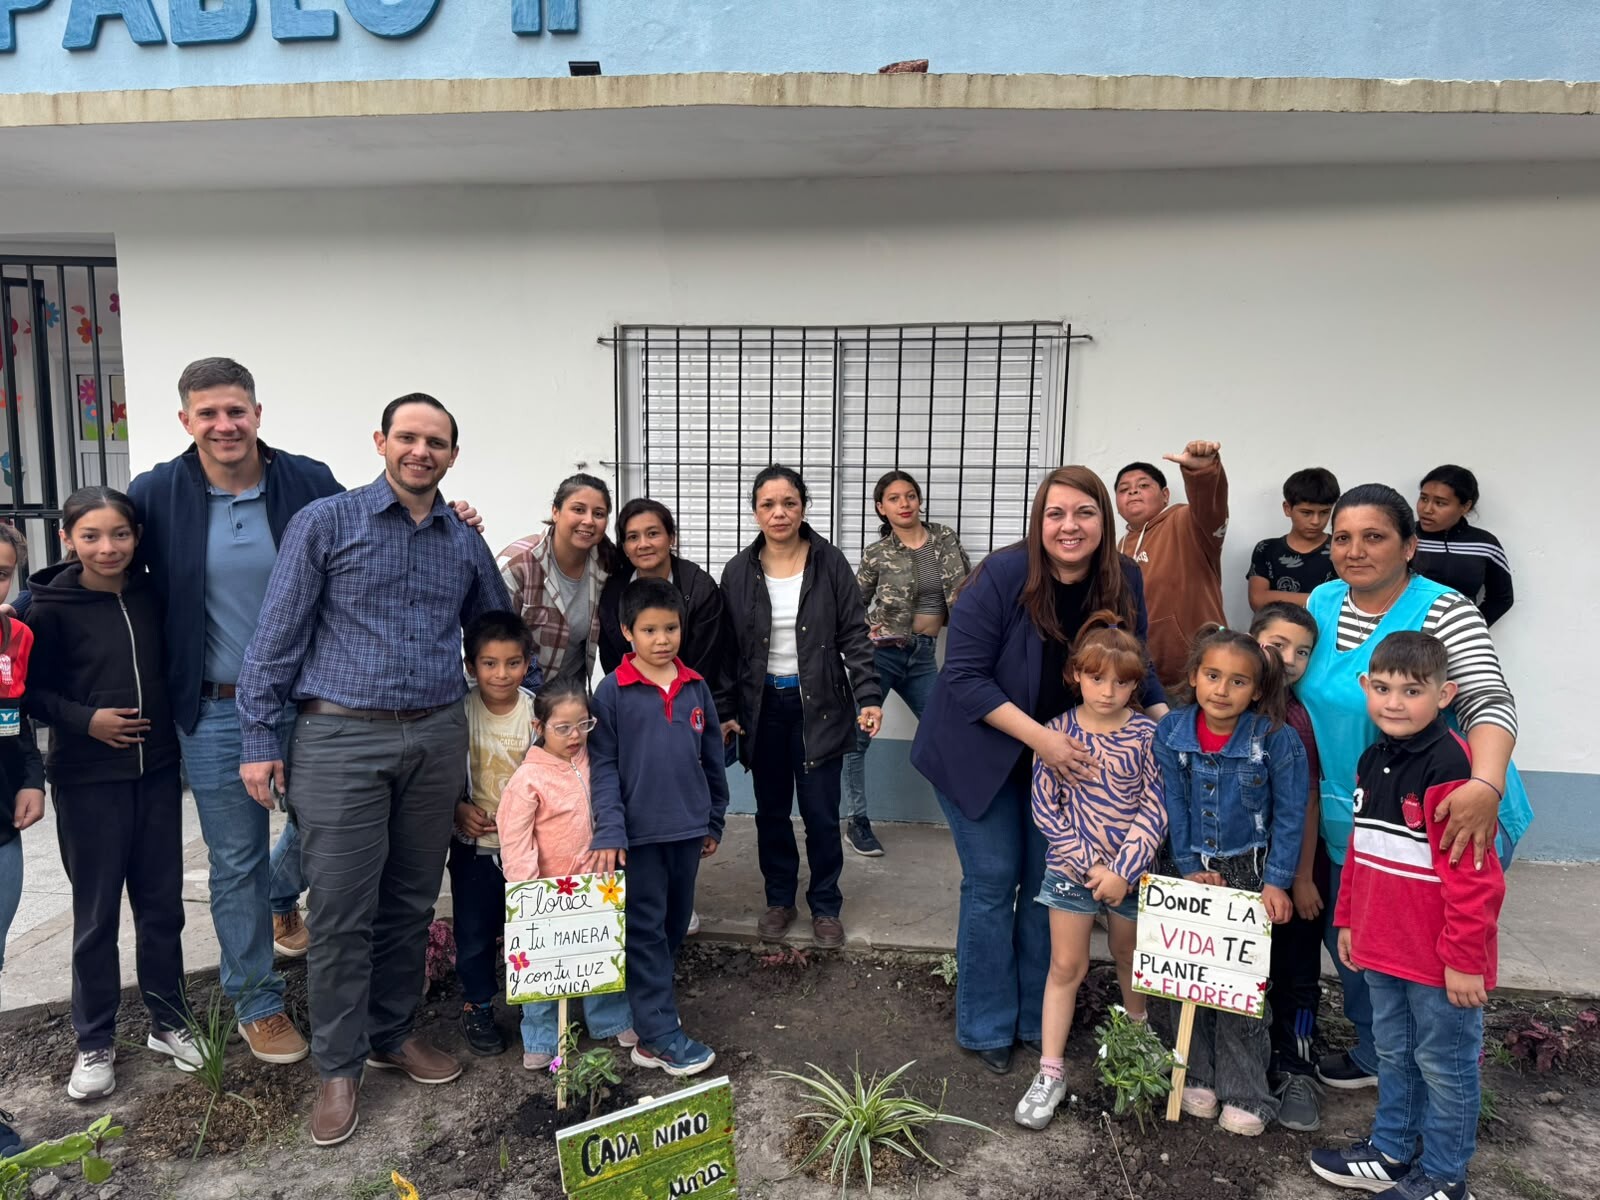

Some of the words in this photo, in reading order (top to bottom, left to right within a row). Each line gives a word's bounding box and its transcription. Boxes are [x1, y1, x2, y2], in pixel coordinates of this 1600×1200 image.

[511, 884, 592, 918] Florece
[1146, 884, 1212, 916] DONDE
[1227, 902, 1256, 925] LA
[510, 936, 520, 951] a
[554, 925, 610, 946] MANERA
[1160, 923, 1215, 957] VIDA
[1223, 937, 1256, 965] TE
[509, 970, 520, 996] y
[577, 961, 604, 978] LUZ
[1161, 978, 1257, 1015] FLORECE
[581, 1133, 641, 1177] CADA
[655, 1112, 709, 1148] NIÑO
